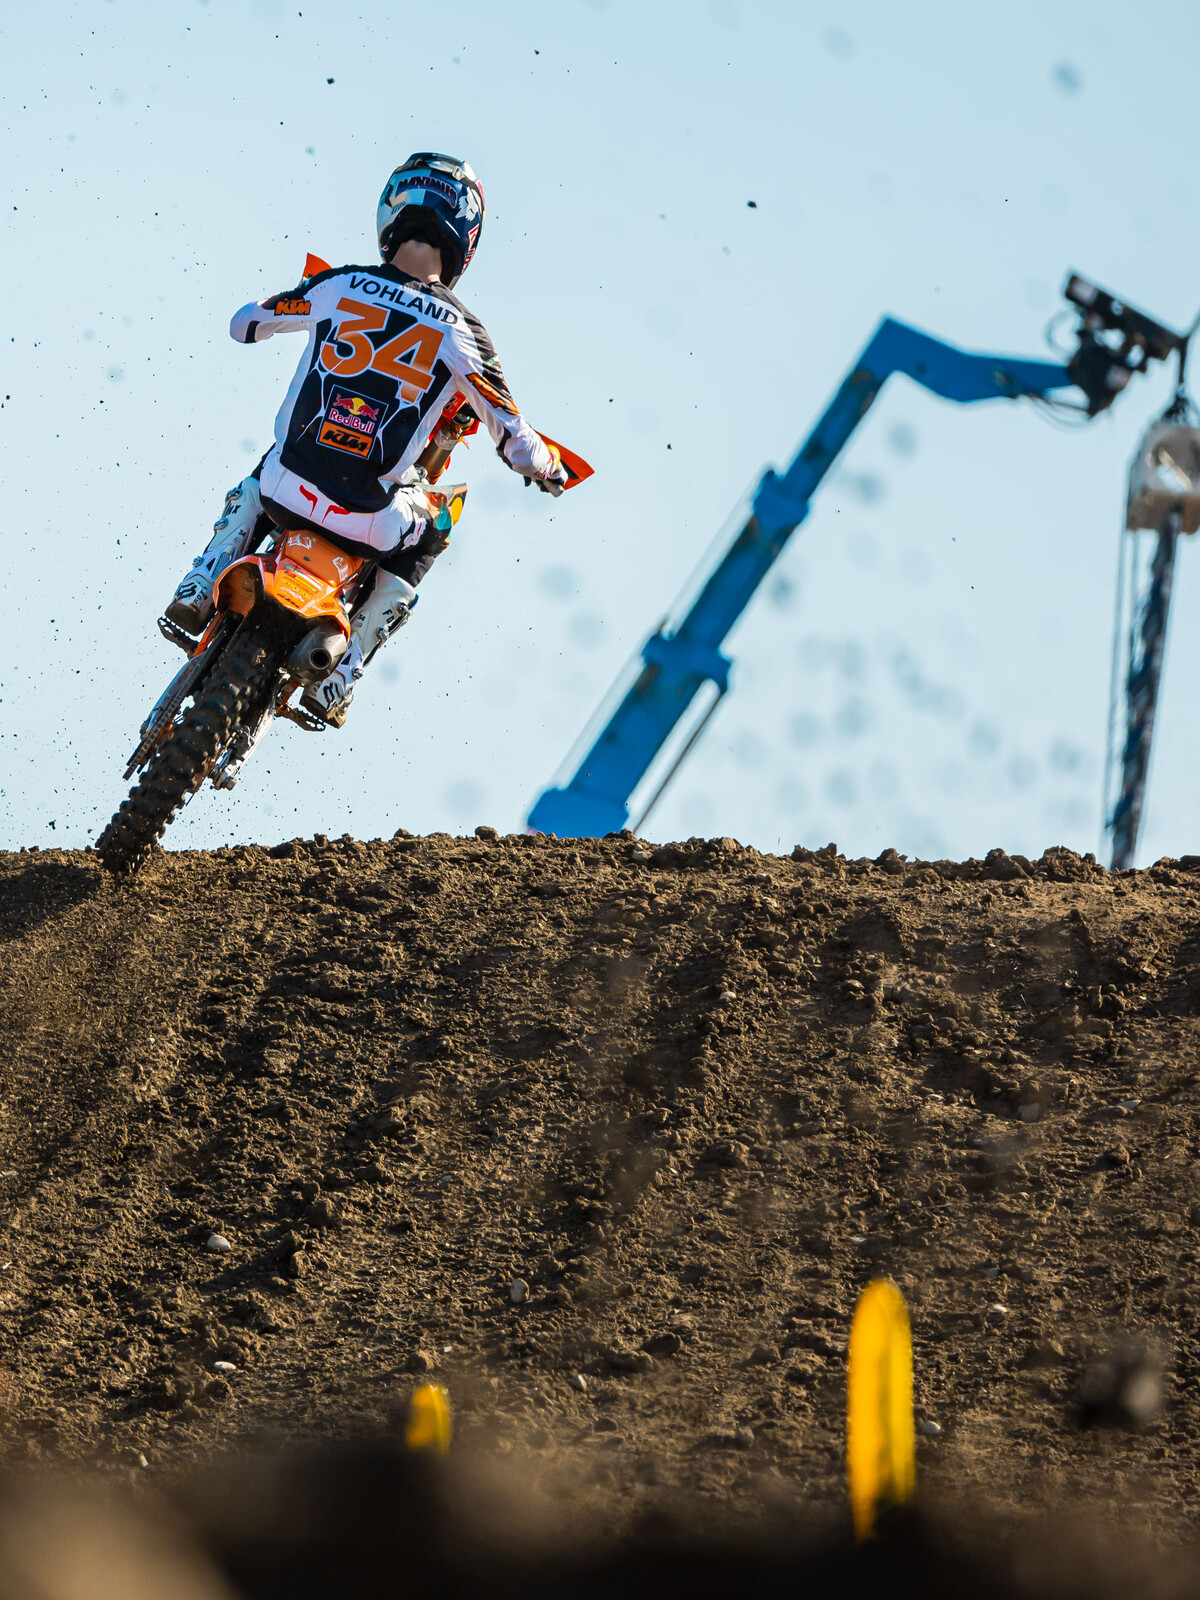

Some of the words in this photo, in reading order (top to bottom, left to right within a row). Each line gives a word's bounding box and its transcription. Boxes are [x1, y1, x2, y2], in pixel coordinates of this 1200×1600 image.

[274, 298, 312, 316] KTM
[349, 275, 458, 325] VOHLAND
[320, 296, 445, 403] 34
[328, 408, 353, 427] Red
[351, 416, 375, 434] Bull
[323, 430, 368, 452] KTM
